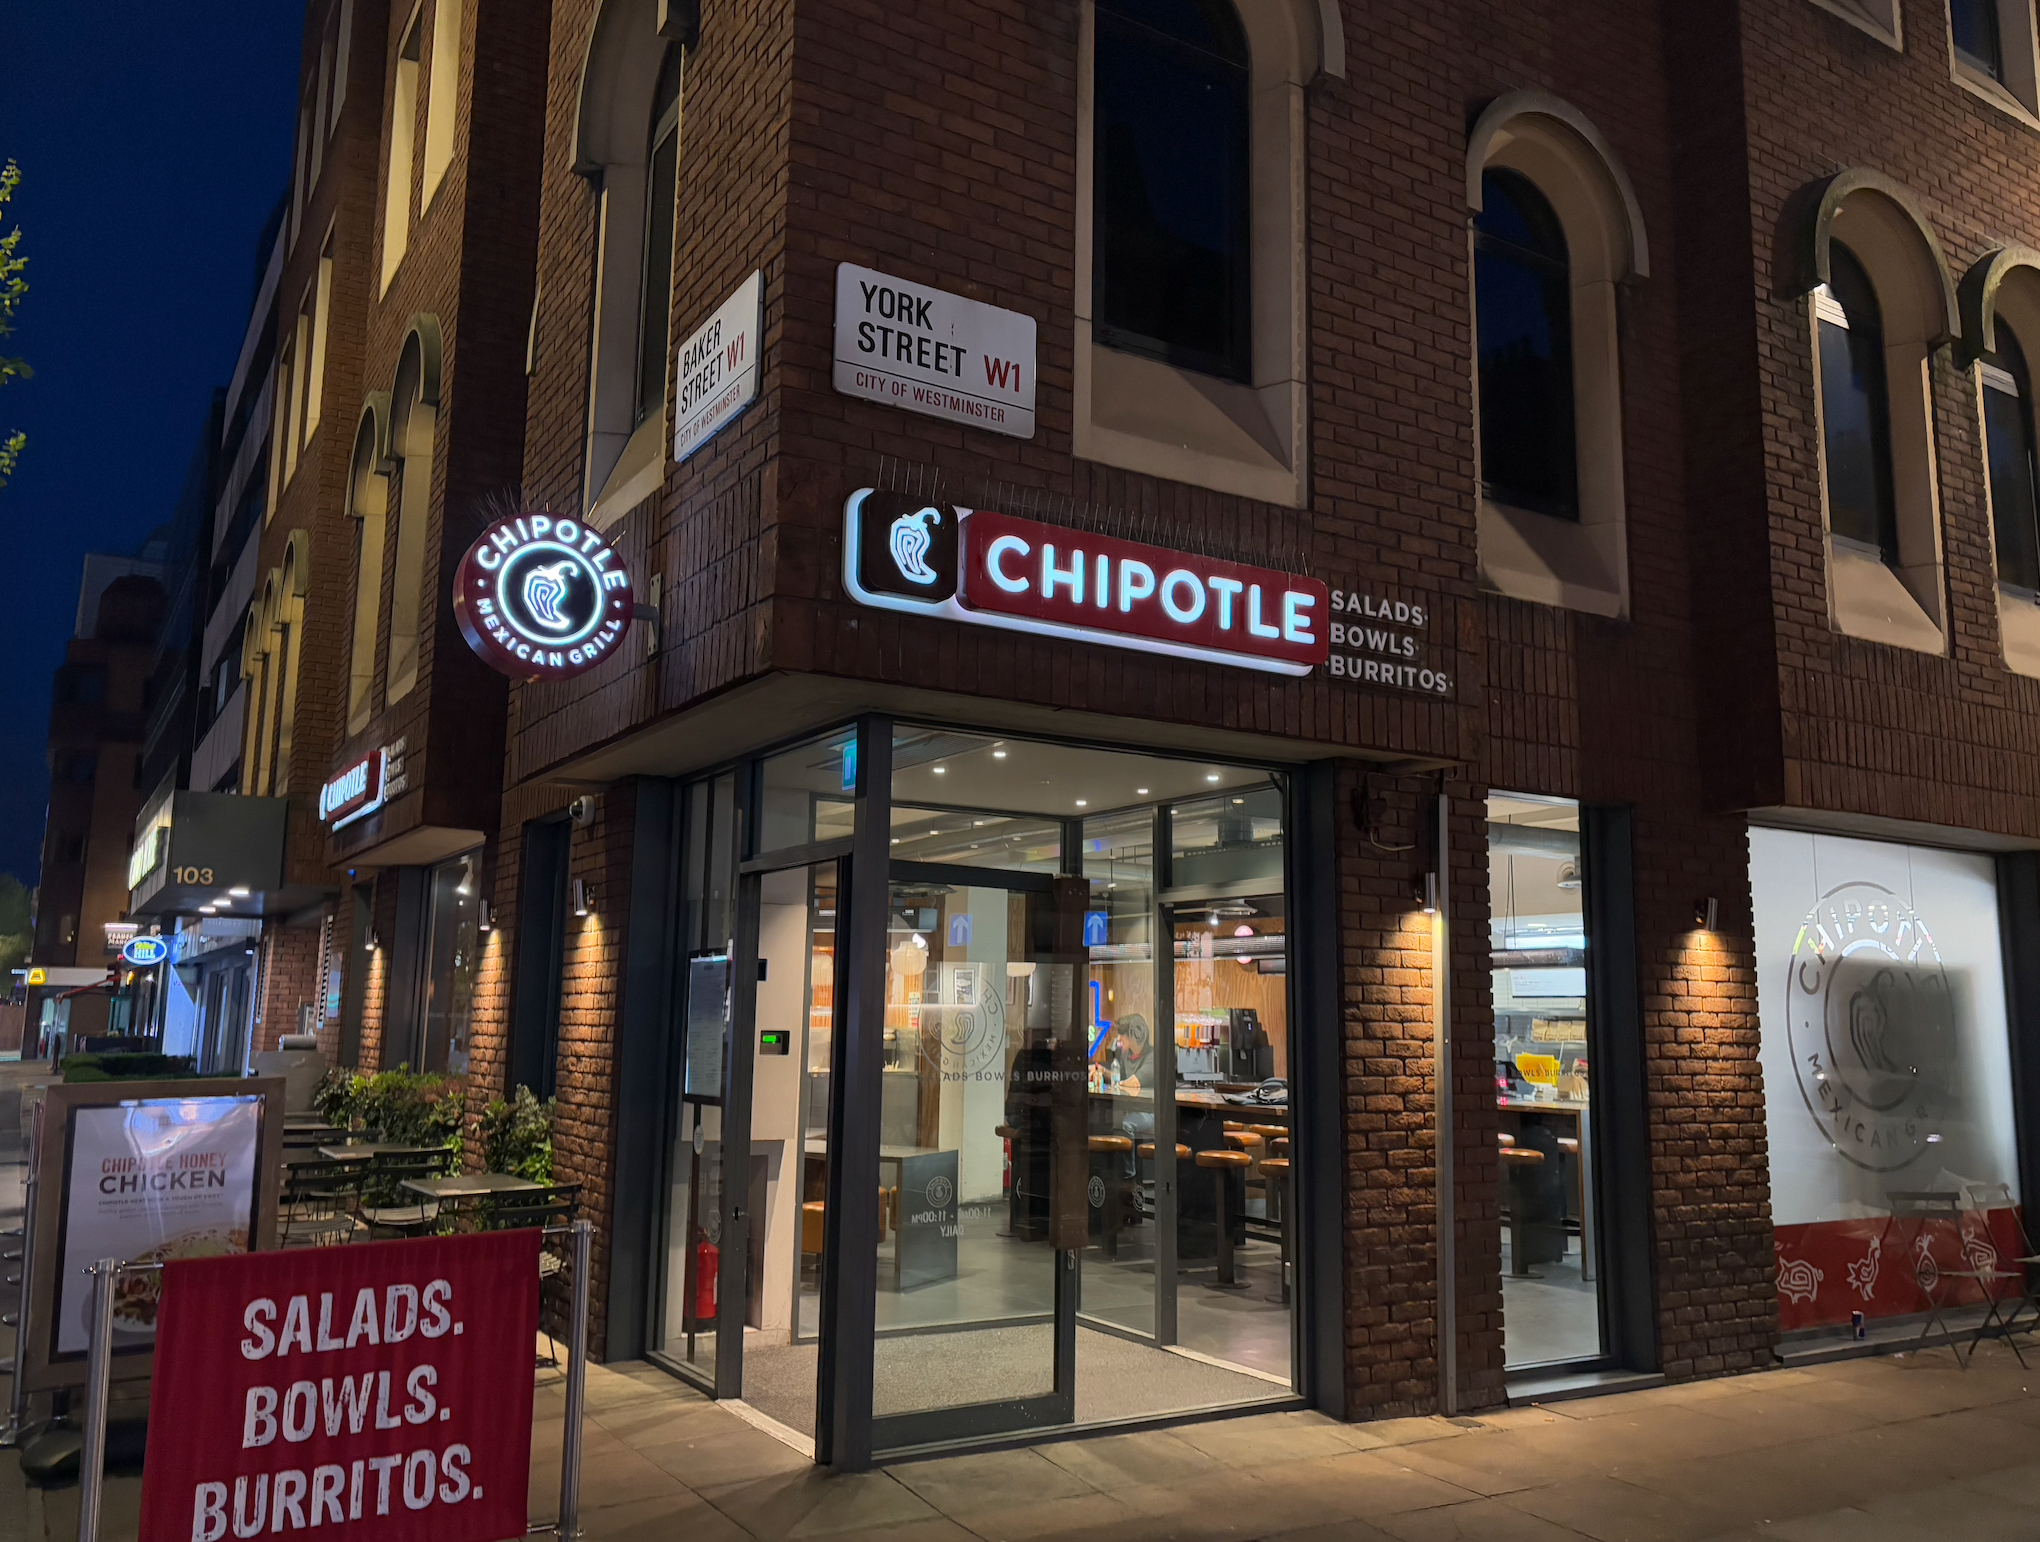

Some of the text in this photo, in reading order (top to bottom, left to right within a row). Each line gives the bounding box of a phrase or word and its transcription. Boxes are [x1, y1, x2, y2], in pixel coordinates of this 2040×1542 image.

[859, 280, 934, 331] YORK
[681, 331, 745, 415] STREET W1
[683, 318, 722, 380] BAKER
[857, 321, 1021, 393] STREET W1
[680, 384, 741, 447] CITY OF WESTMINSTER
[856, 371, 1006, 424] CITY OF WESTMINSTER
[476, 514, 628, 591] CHIPOTLE
[986, 534, 1317, 645] CHIPOTLE
[1330, 589, 1424, 626] SALADS
[476, 597, 622, 667] MEXICAN GRILL
[1329, 622, 1415, 657] BOWLS
[1329, 654, 1448, 692] BURRITOS
[326, 760, 369, 812] CHIPOTLE
[173, 865, 214, 885] 103
[974, 1071, 1021, 1081] BOWS
[1026, 1070, 1087, 1081] BURRITOS
[1807, 1052, 1899, 1149] MEXICAN
[99, 1169, 226, 1194] CHICKEN
[179, 1151, 227, 1169] HONEY
[240, 1278, 464, 1361] SALADS.
[242, 1364, 450, 1449] BOWLS.
[191, 1443, 483, 1542] BURRITOS.
